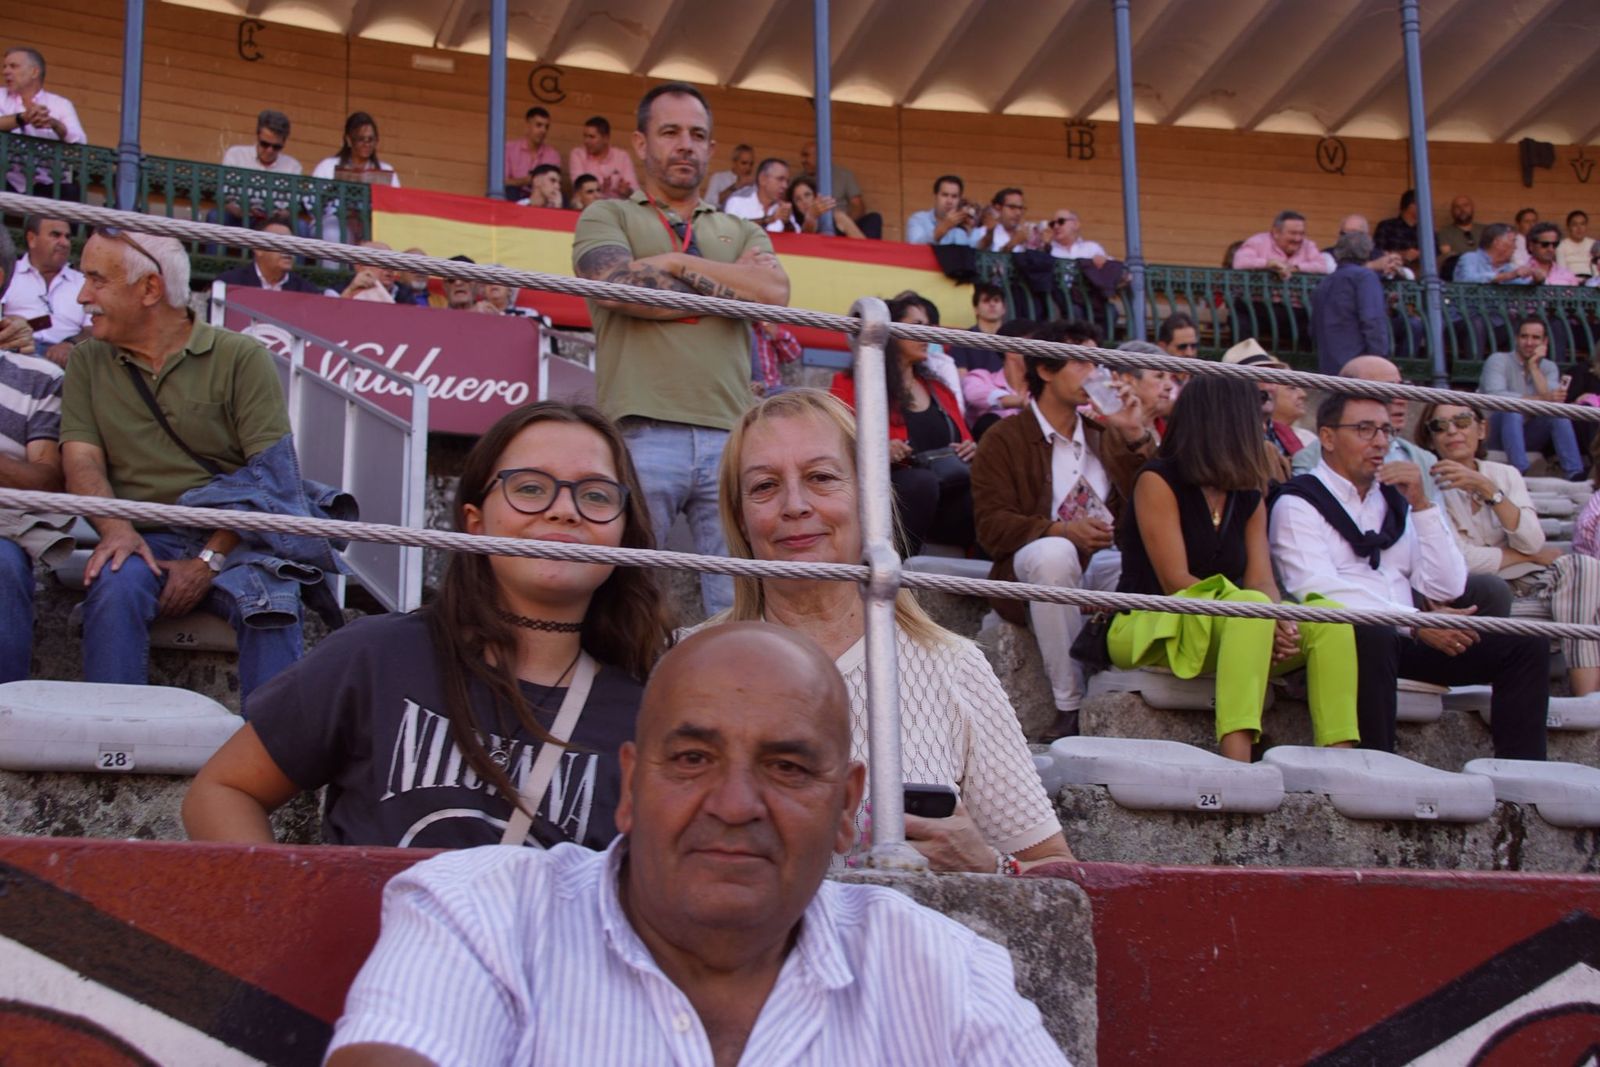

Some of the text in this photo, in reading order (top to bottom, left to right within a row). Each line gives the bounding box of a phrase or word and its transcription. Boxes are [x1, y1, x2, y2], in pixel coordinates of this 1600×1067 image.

[176, 632, 195, 643] 24
[103, 752, 127, 767] 28
[1200, 794, 1217, 807] 24
